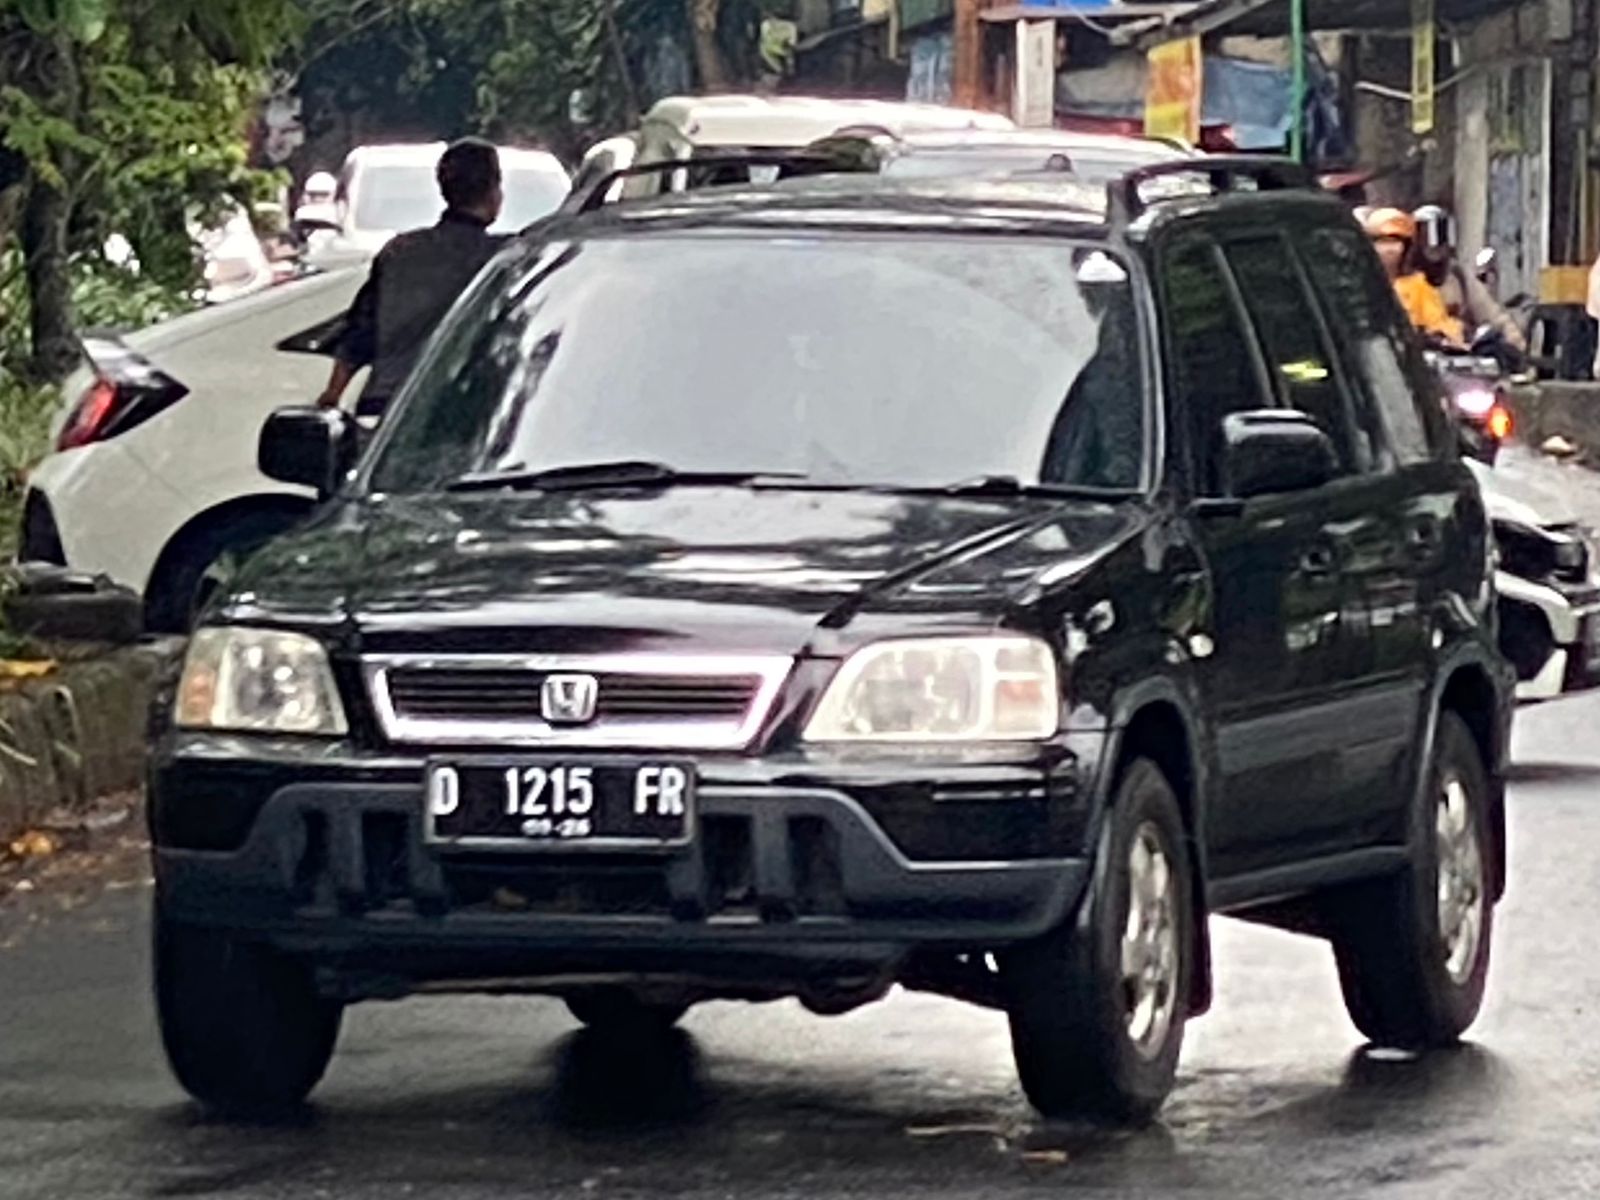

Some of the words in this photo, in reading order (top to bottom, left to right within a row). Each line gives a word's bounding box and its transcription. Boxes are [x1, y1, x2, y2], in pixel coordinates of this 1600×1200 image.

[432, 767, 459, 815] D
[505, 767, 593, 815] 1215
[634, 767, 686, 815] FR
